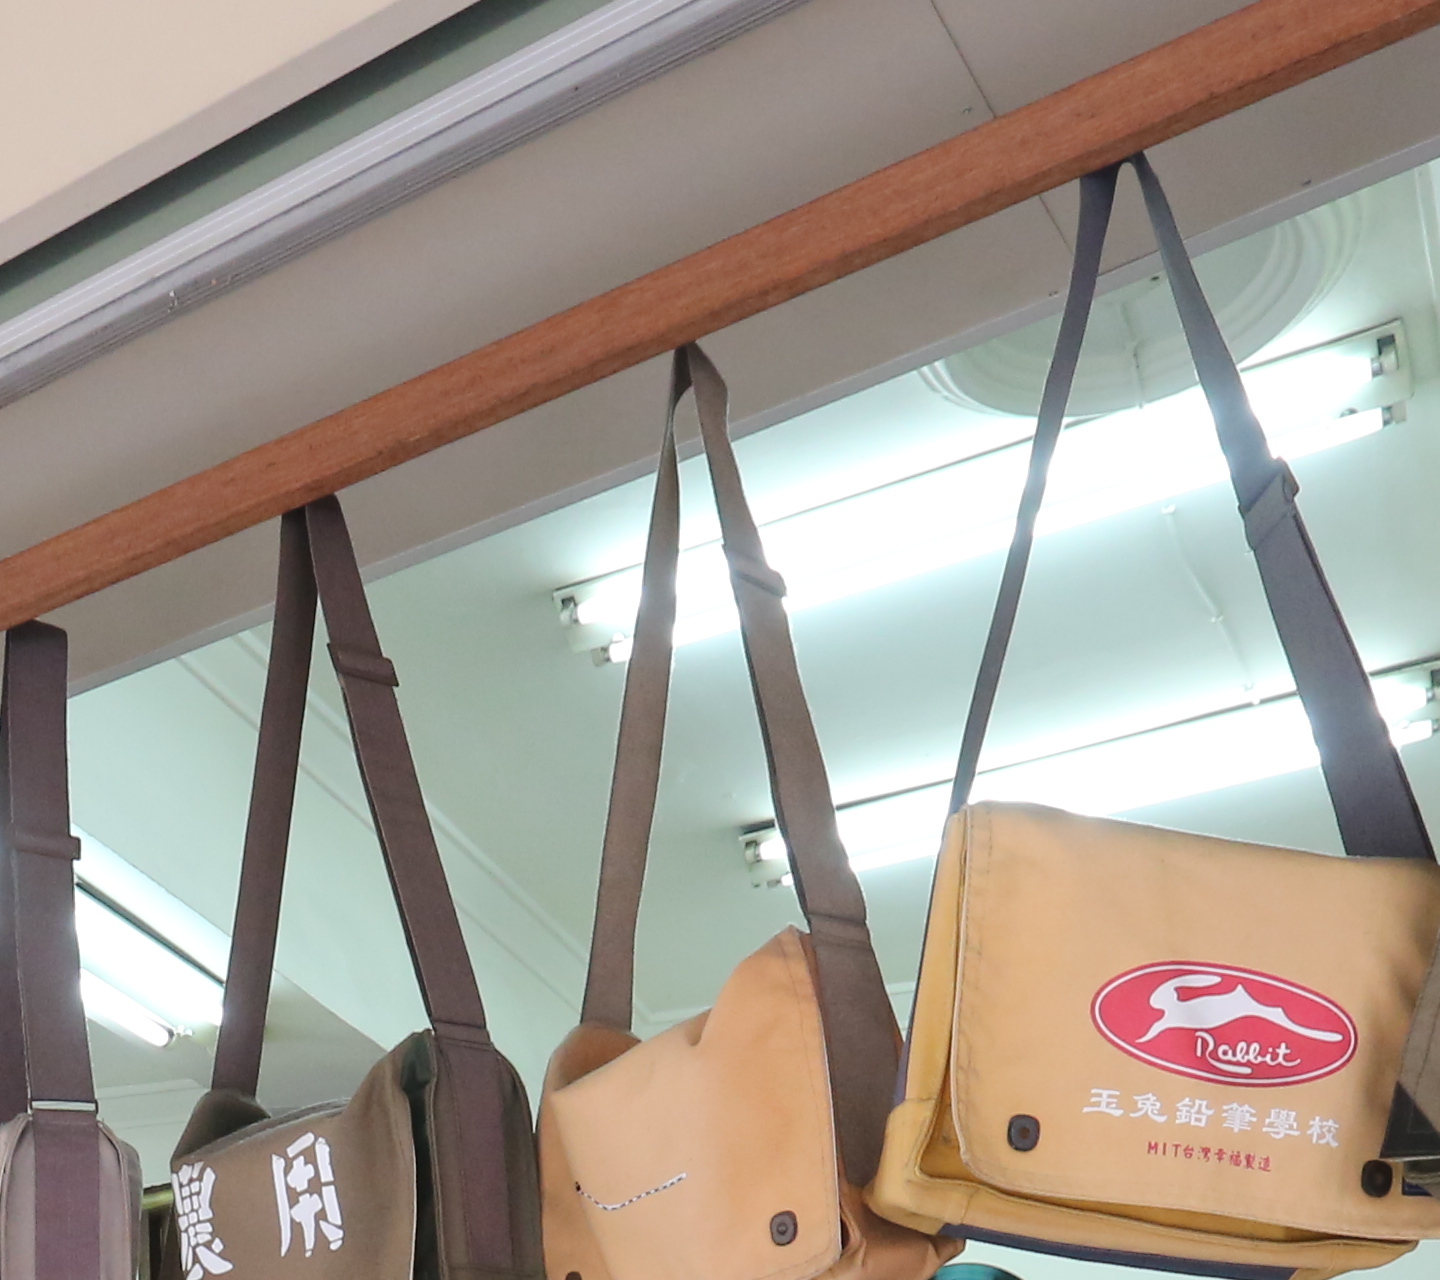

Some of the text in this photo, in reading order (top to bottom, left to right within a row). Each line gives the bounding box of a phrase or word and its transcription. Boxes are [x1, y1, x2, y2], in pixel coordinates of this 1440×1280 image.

[1196, 1031, 1301, 1074] Rabbit
[1082, 1088, 1340, 1149] 玉兔鉛筆學校
